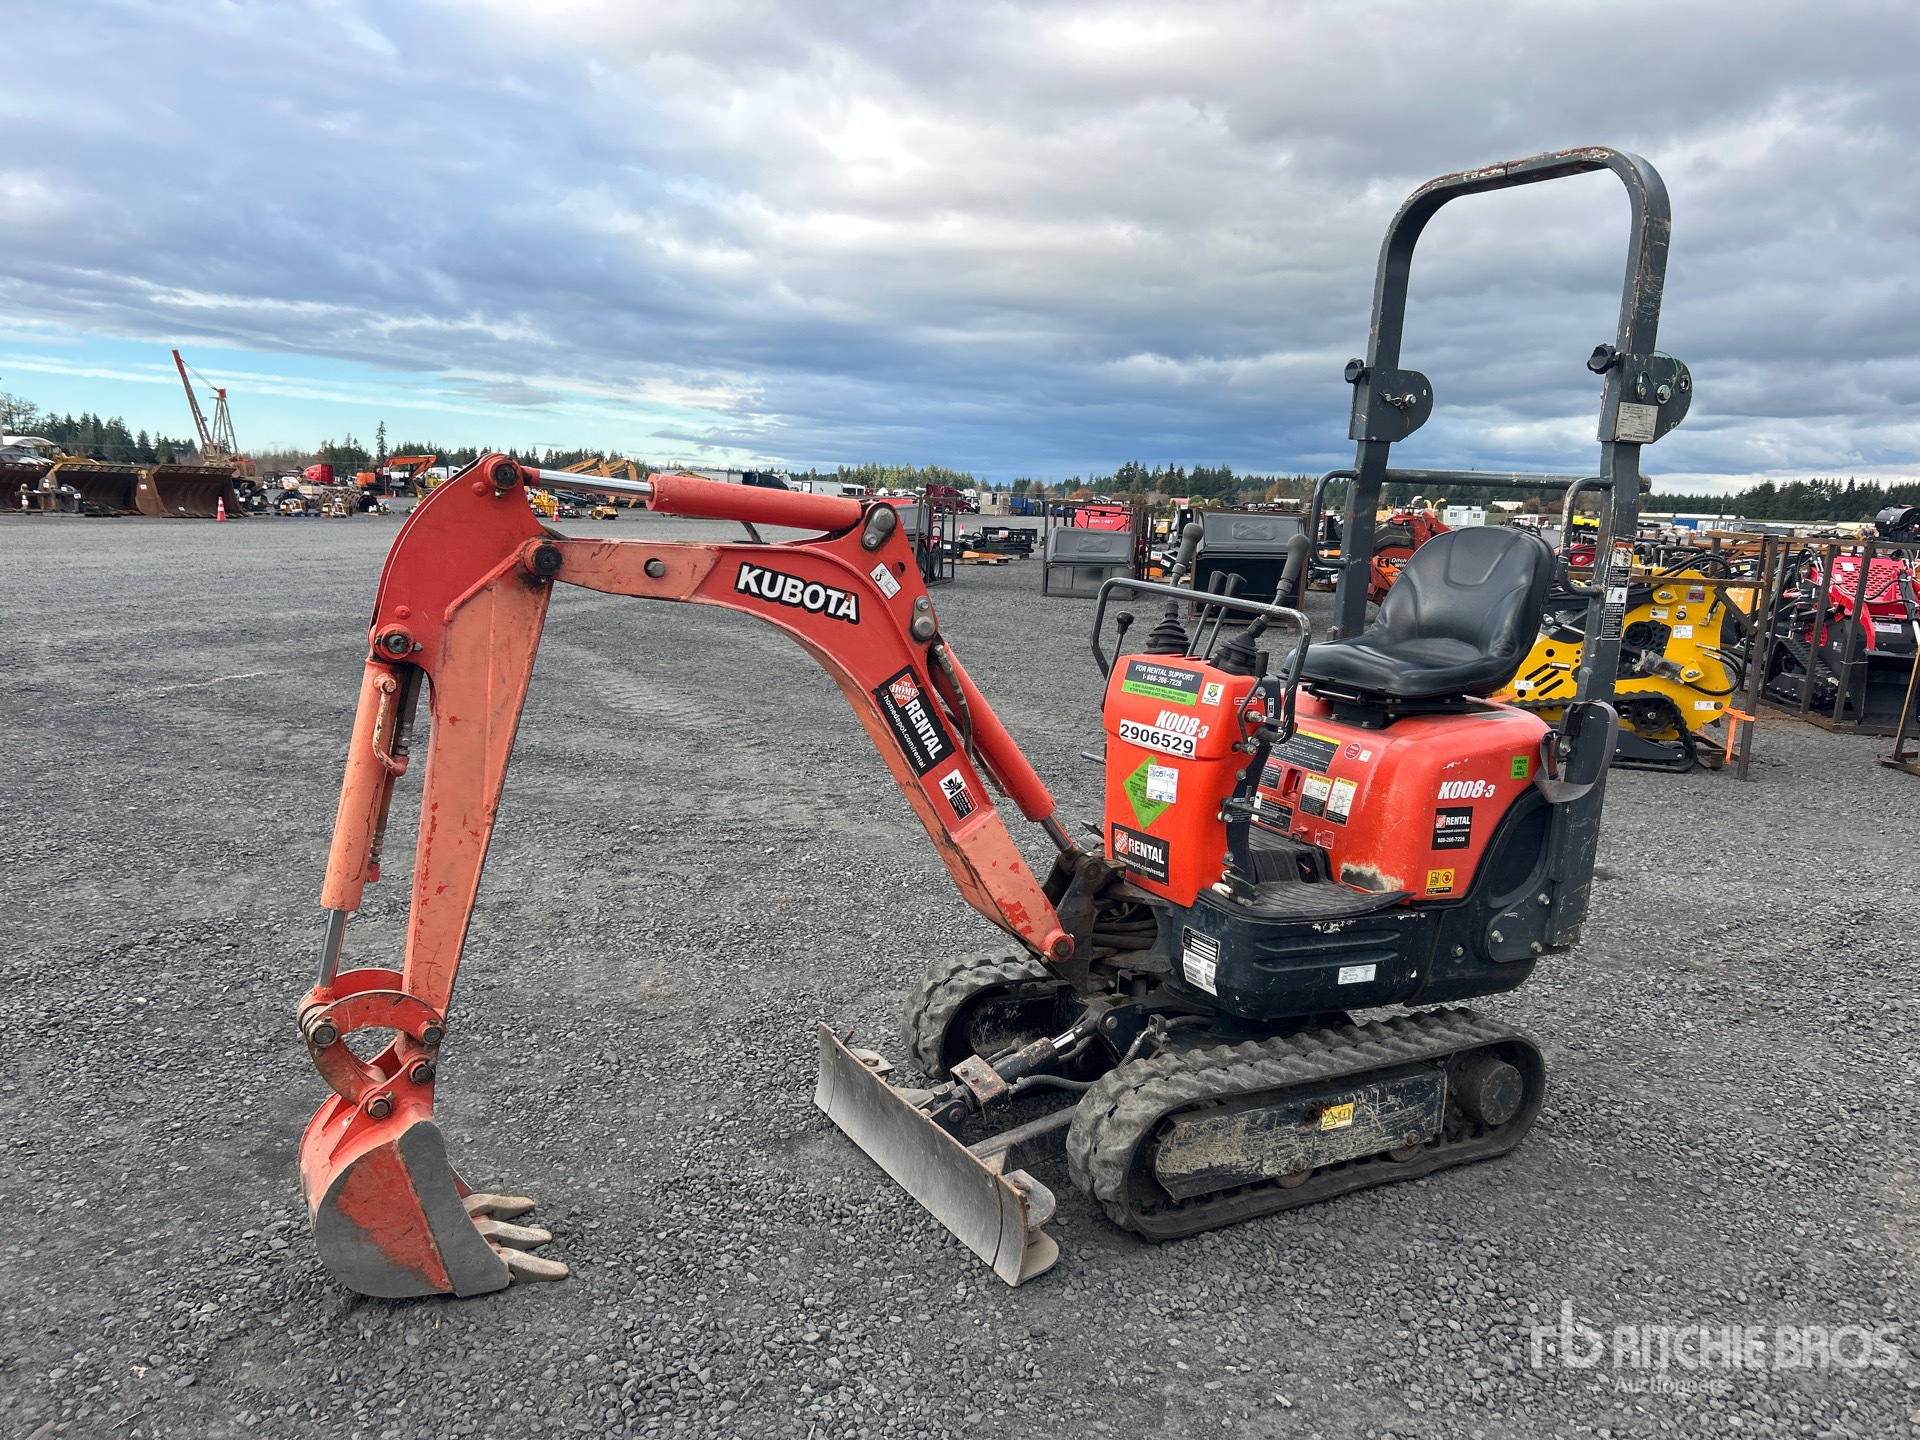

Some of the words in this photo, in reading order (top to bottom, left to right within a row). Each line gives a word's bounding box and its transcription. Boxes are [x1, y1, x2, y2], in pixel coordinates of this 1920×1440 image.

[738, 565, 857, 620] KUBOTA
[1135, 664, 1147, 672] FOR
[1147, 666, 1167, 676] RENTAL
[1168, 670, 1195, 681] SUPPORT
[892, 683, 916, 696] HOME
[883, 694, 926, 769] homedepot.com/rental
[904, 698, 943, 760] RENTAL
[1120, 723, 1194, 754] 2906529
[1155, 709, 1209, 739] K008-3
[1437, 779, 1496, 800] K008-3
[1446, 815, 1471, 826] RENTAL
[1128, 837, 1165, 865] RENTAL
